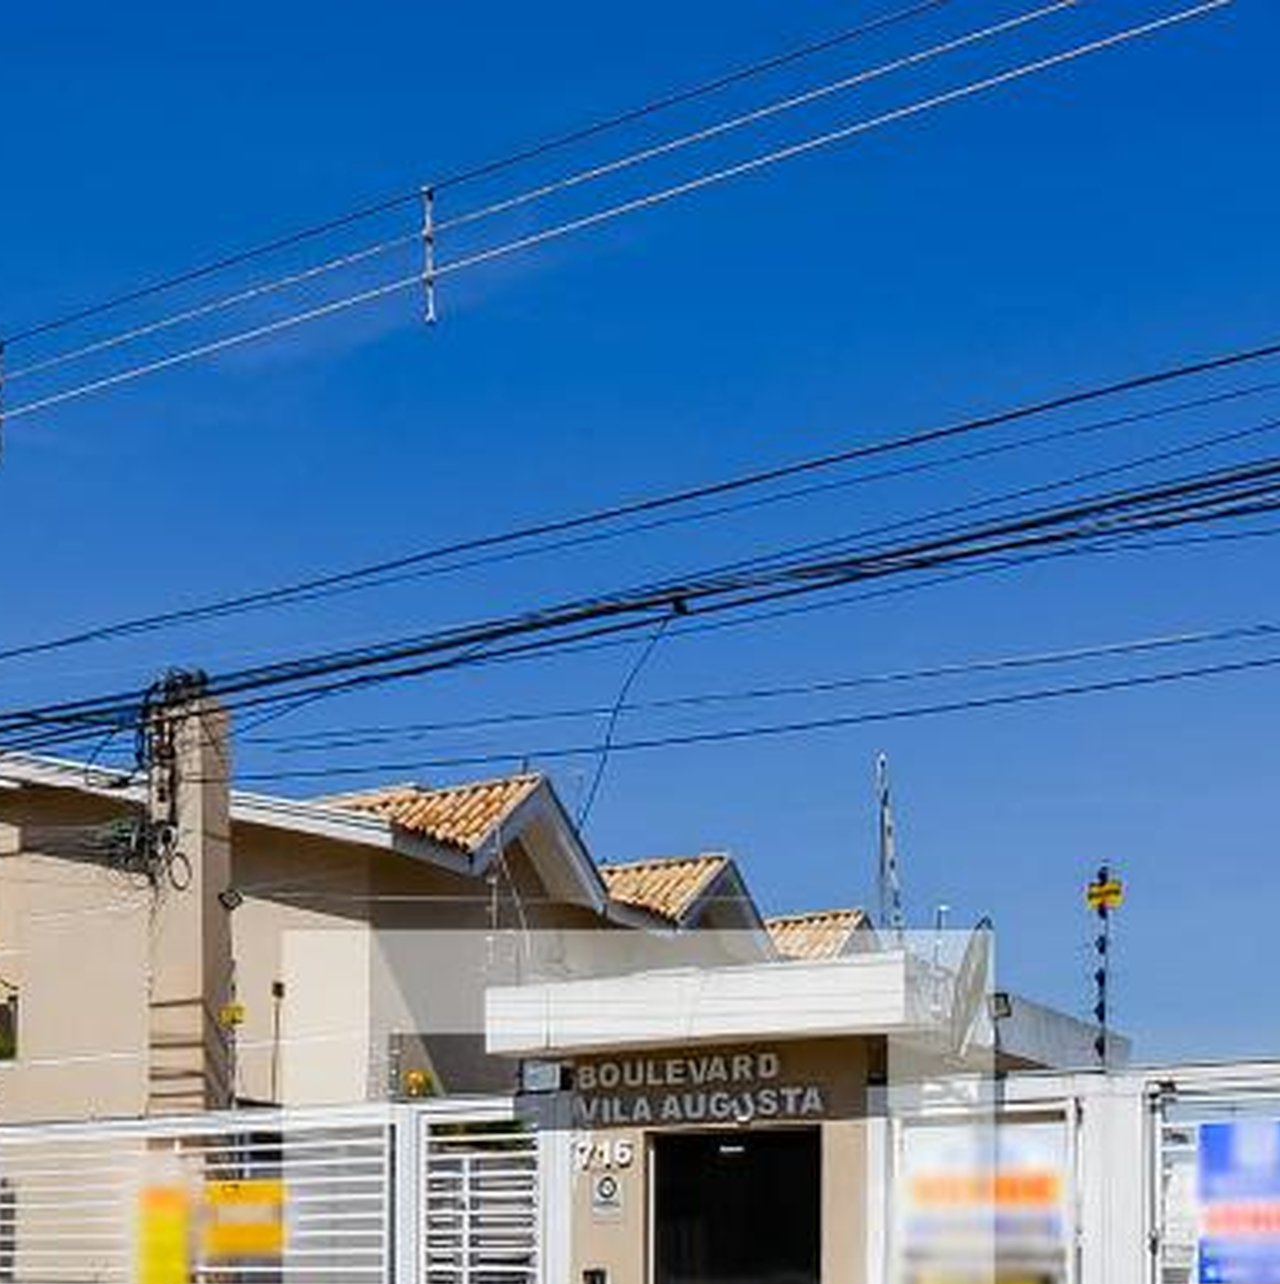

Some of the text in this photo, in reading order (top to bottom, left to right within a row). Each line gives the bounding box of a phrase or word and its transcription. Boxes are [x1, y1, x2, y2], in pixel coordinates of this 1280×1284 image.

[577, 1052, 780, 1090] BOULEVARD
[576, 1086, 824, 1124] VILA AUGUSTA
